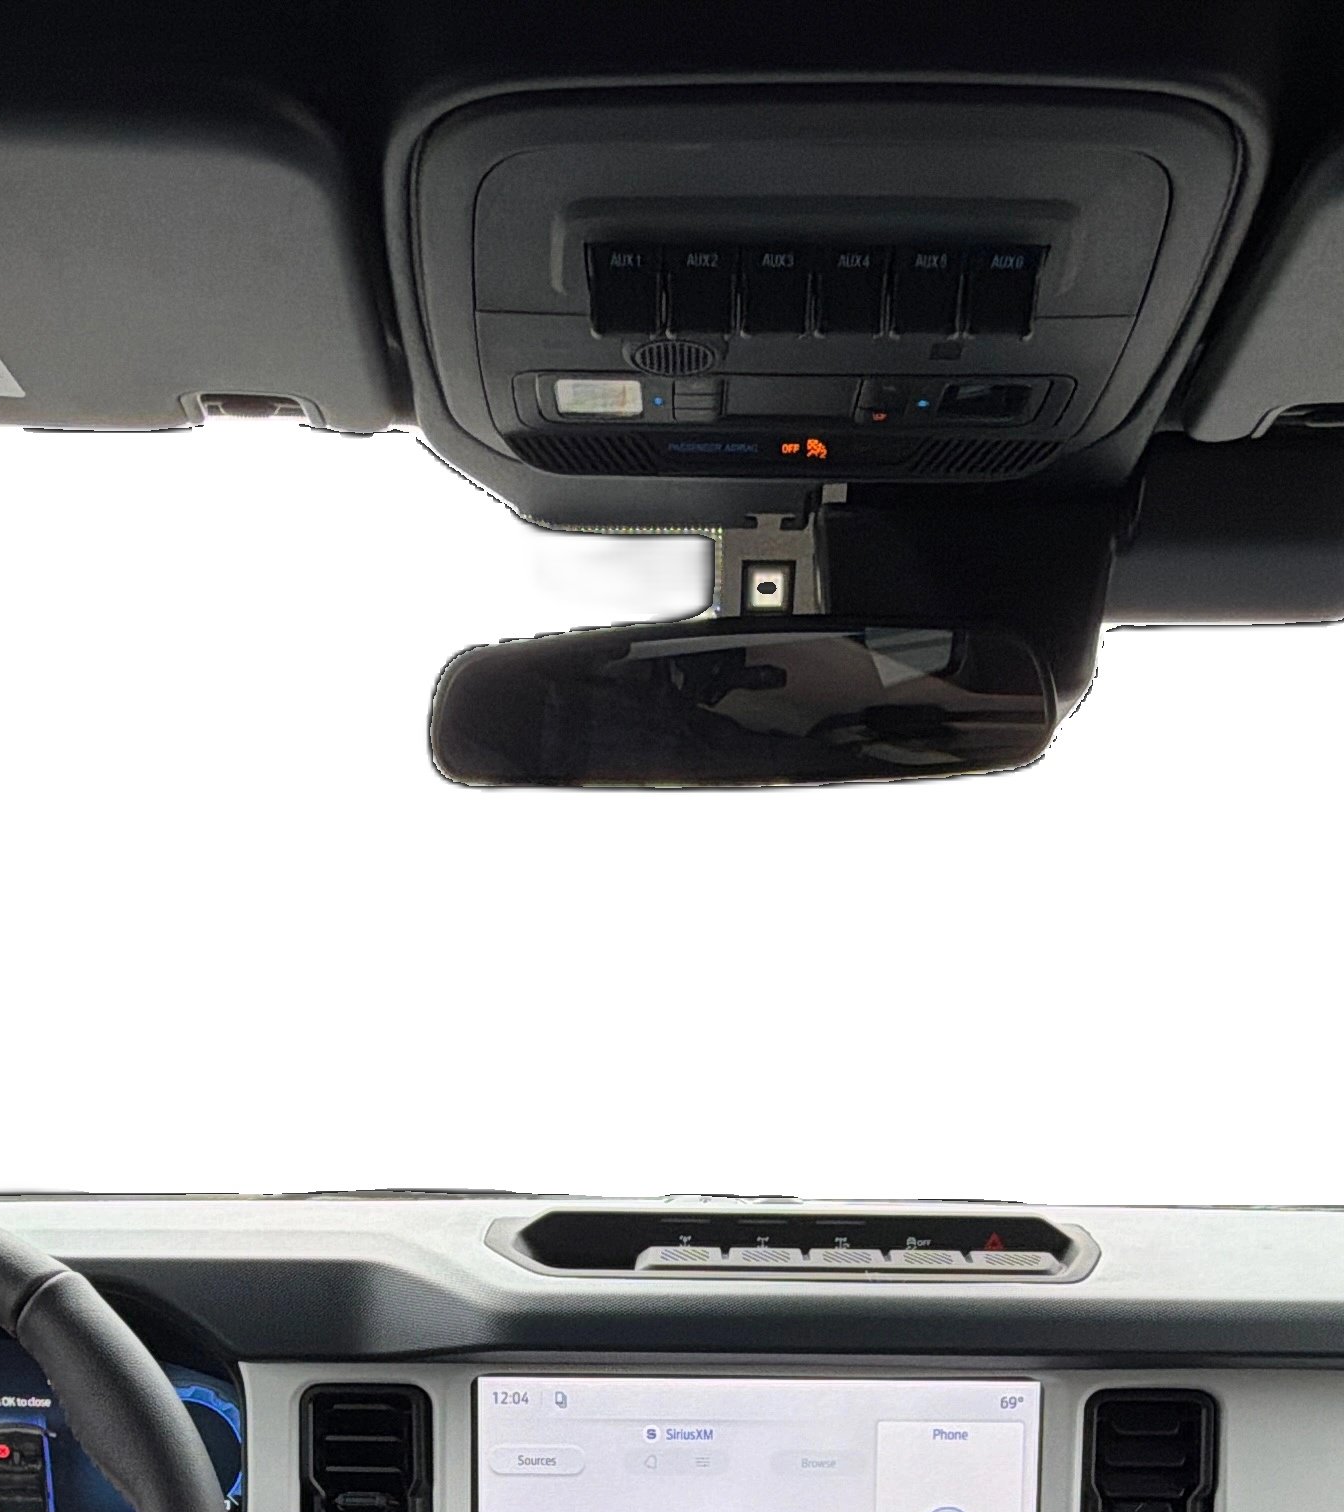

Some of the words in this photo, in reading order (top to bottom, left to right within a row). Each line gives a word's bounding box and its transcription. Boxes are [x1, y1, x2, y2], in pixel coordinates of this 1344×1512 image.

[782, 444, 800, 453] OFF
[1, 1396, 16, 1407] OK
[16, 1397, 26, 1408] to
[26, 1397, 52, 1408] close
[492, 1392, 529, 1405] 12:04
[1000, 1396, 1024, 1409] 69°
[666, 1428, 714, 1441] SiriusXM
[932, 1428, 968, 1441] Phone
[517, 1455, 557, 1466] Sources
[801, 1458, 836, 1469] Browse
